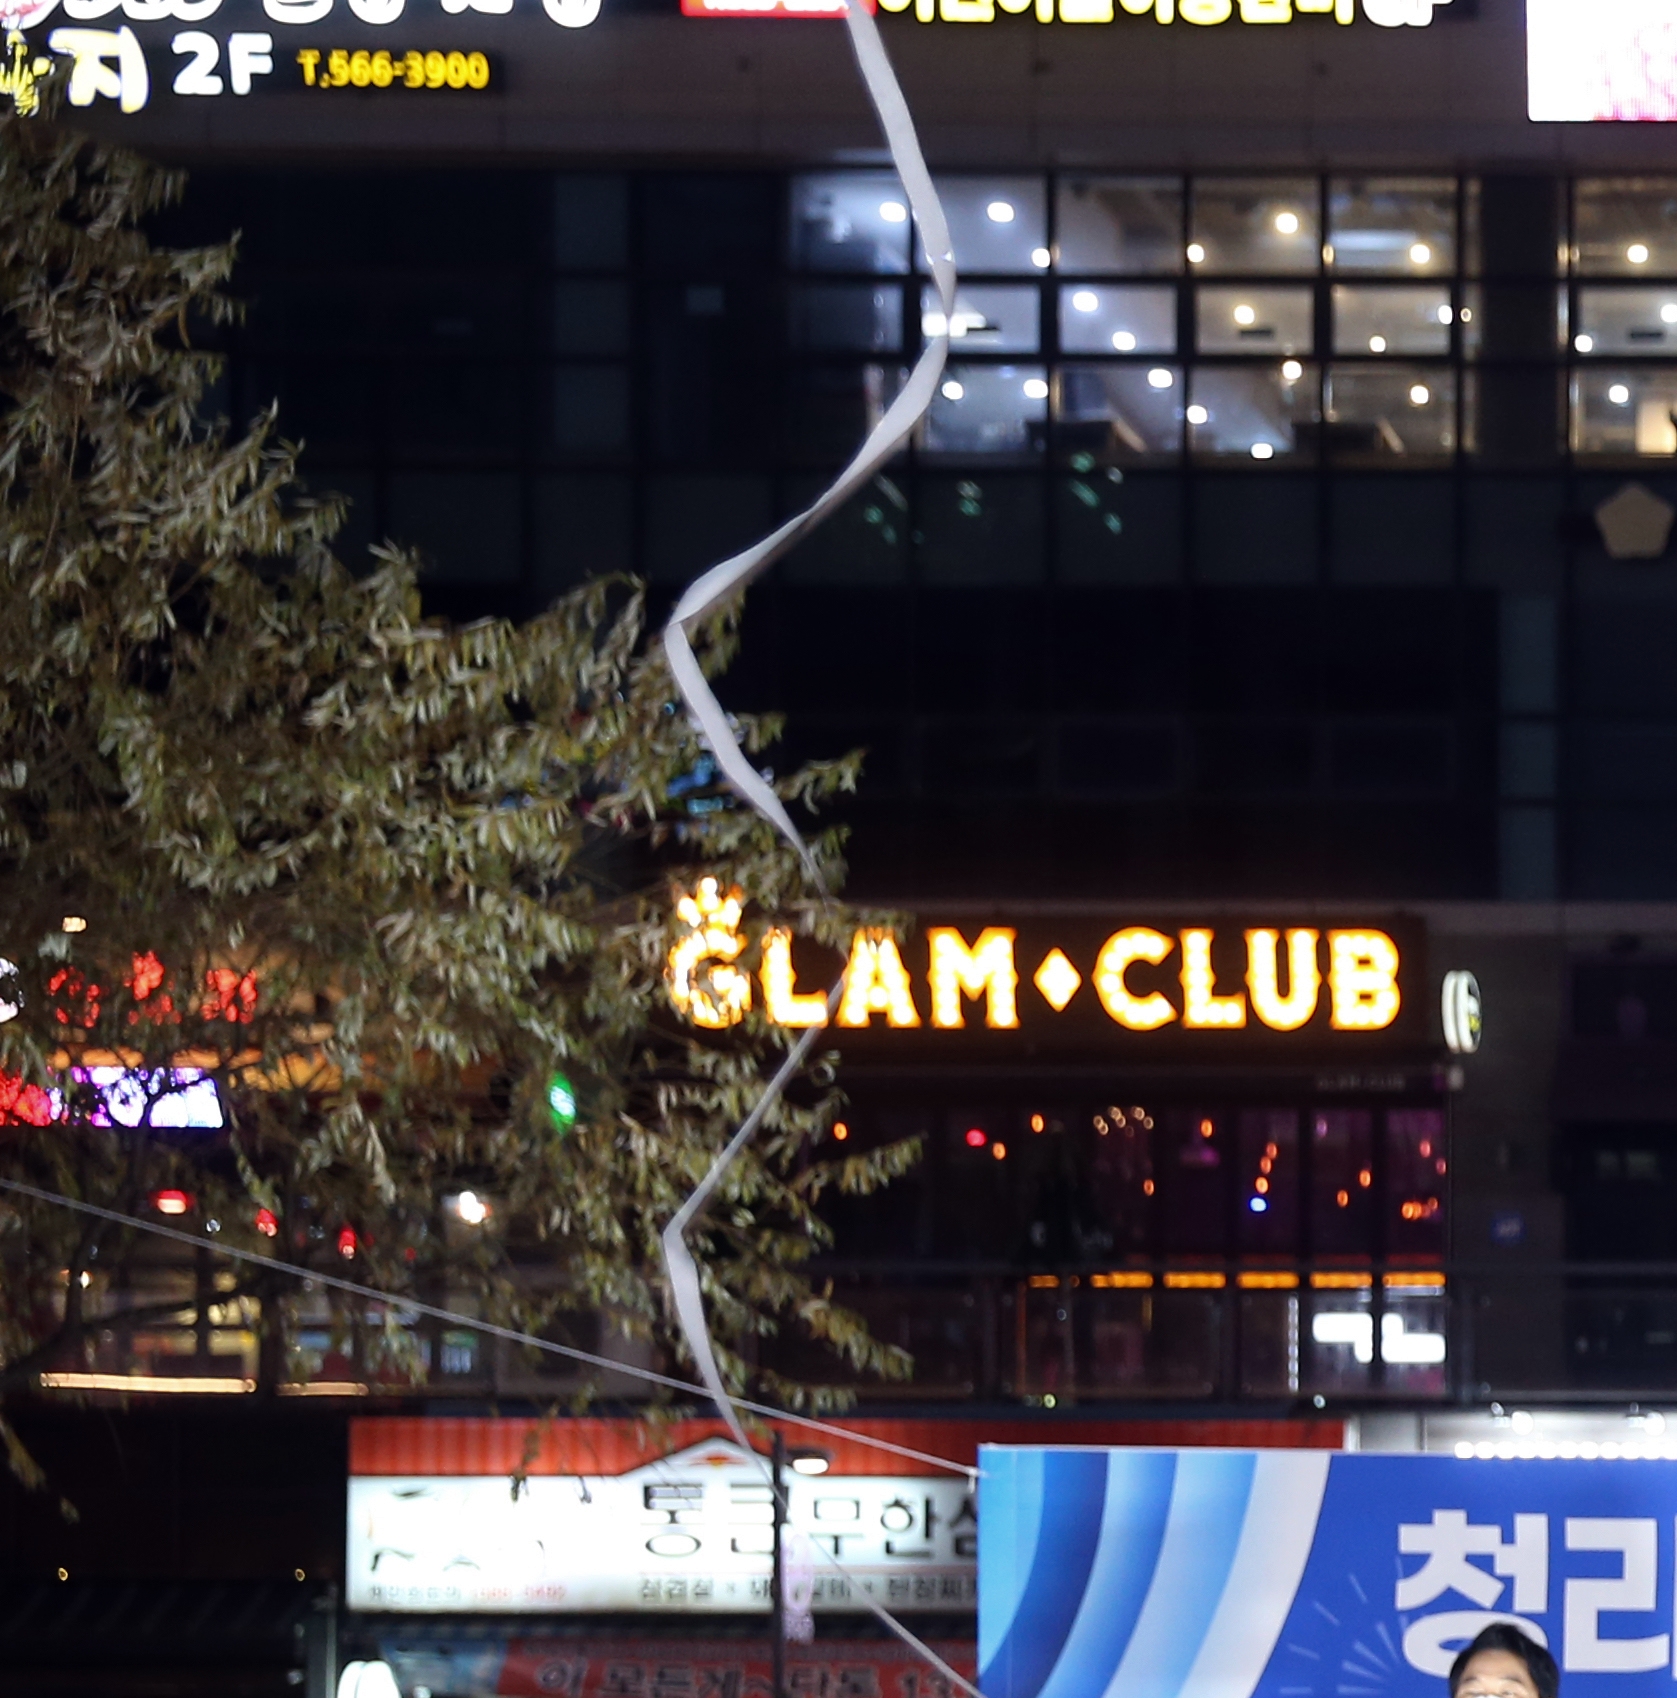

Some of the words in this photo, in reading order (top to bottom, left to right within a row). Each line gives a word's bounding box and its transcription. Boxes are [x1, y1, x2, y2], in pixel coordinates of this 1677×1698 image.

[171, 31, 273, 96] 2F
[666, 926, 1020, 1029] GLAM
[1096, 927, 1402, 1032] CLUB
